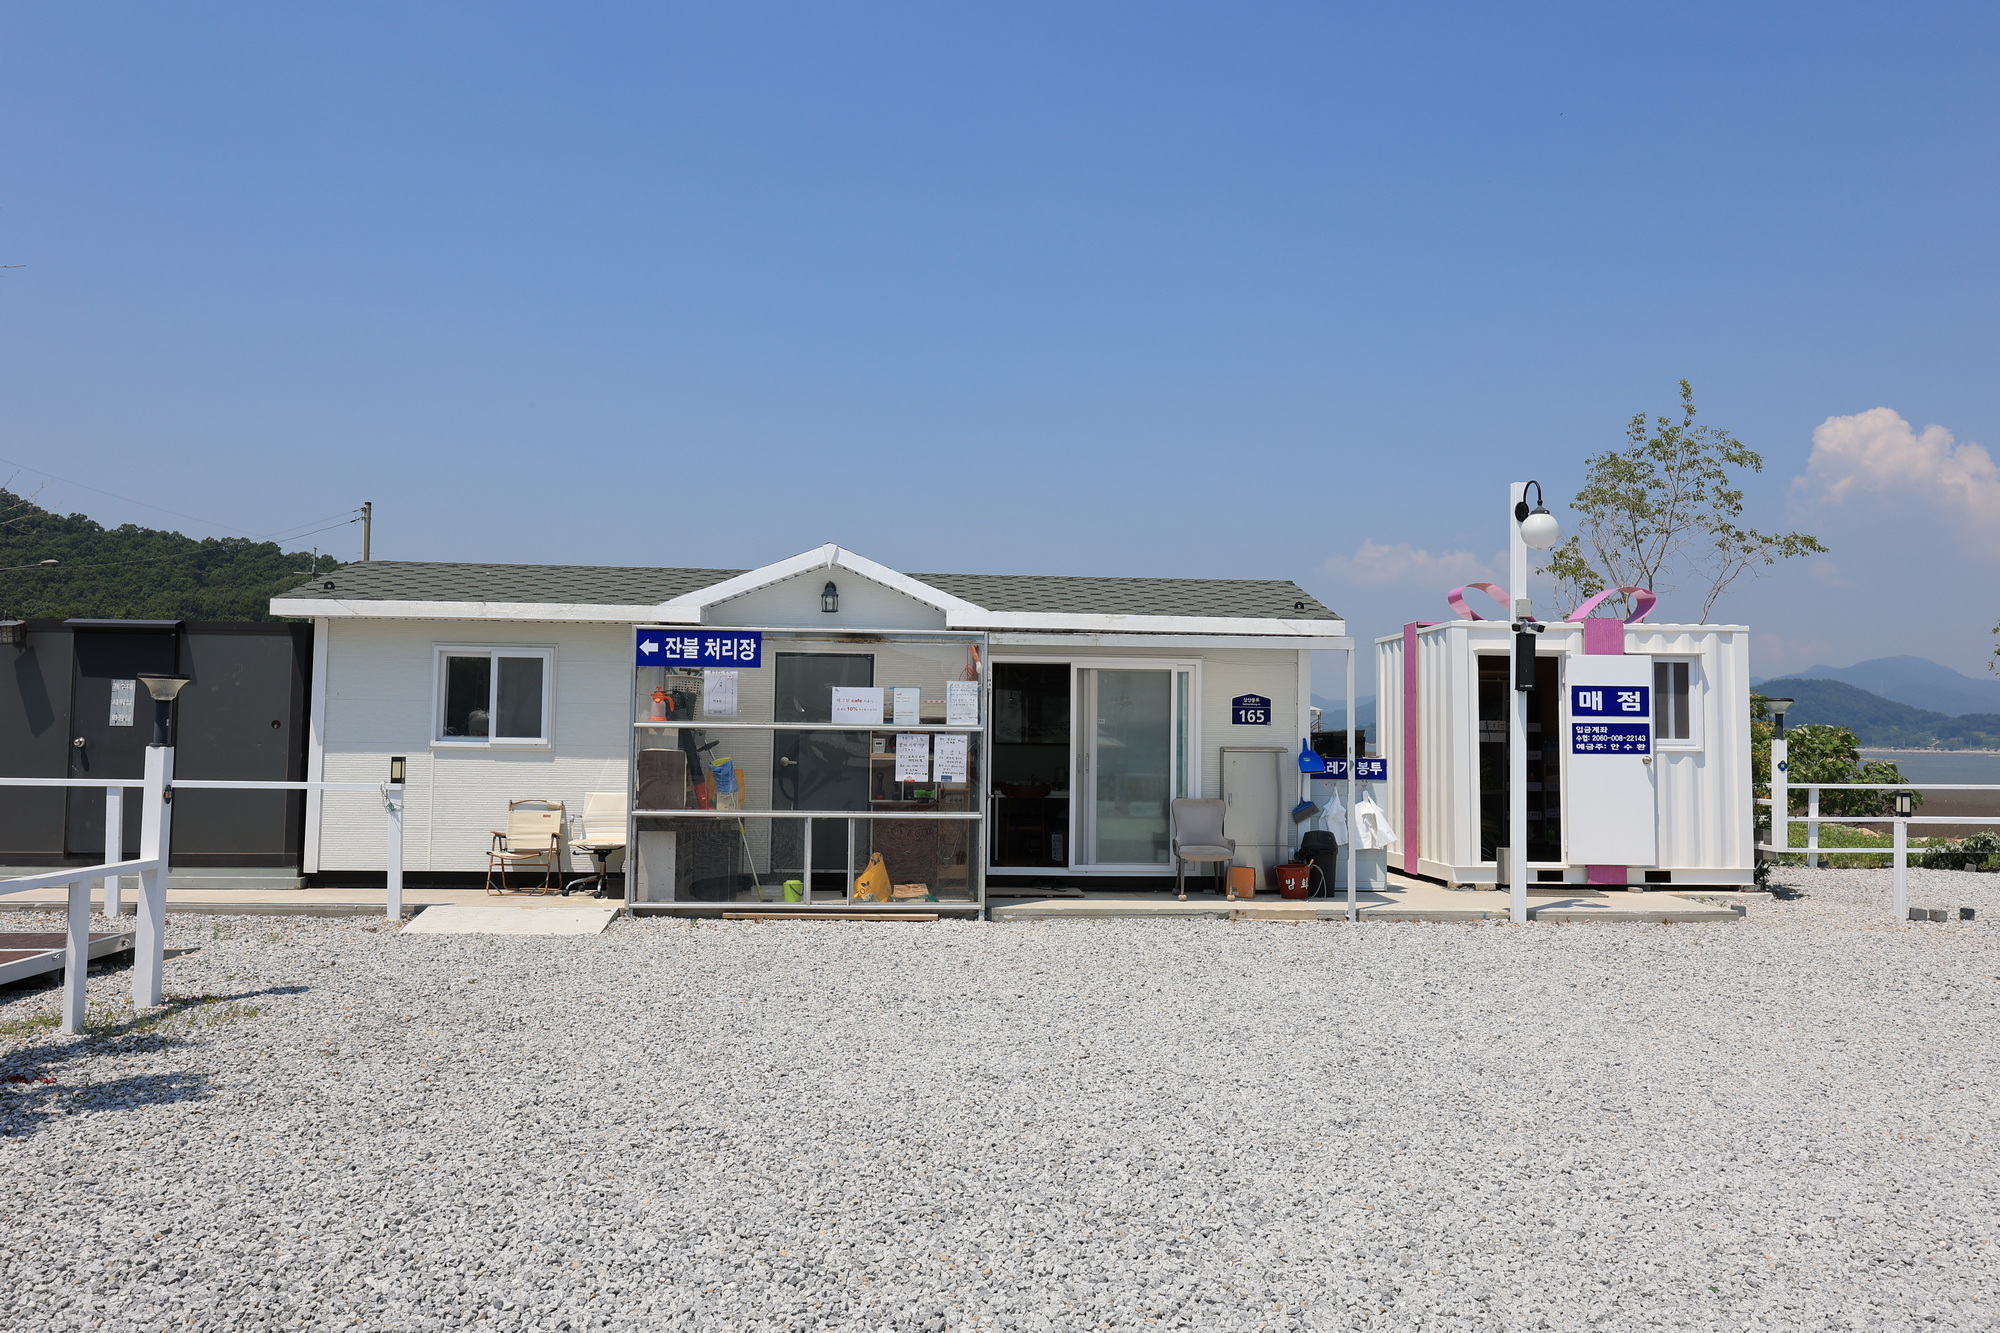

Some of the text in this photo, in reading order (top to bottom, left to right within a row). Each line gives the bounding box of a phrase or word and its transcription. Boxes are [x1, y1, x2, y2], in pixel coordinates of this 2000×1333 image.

[664, 636, 757, 661] 잔불 처리장
[1239, 709, 1265, 723] 165
[1575, 726, 1608, 734] 입금계좌
[1575, 734, 1646, 742] 수협: 2060-008-22143
[1576, 743, 1607, 751] 예금주:
[1356, 761, 1383, 776] 봉투
